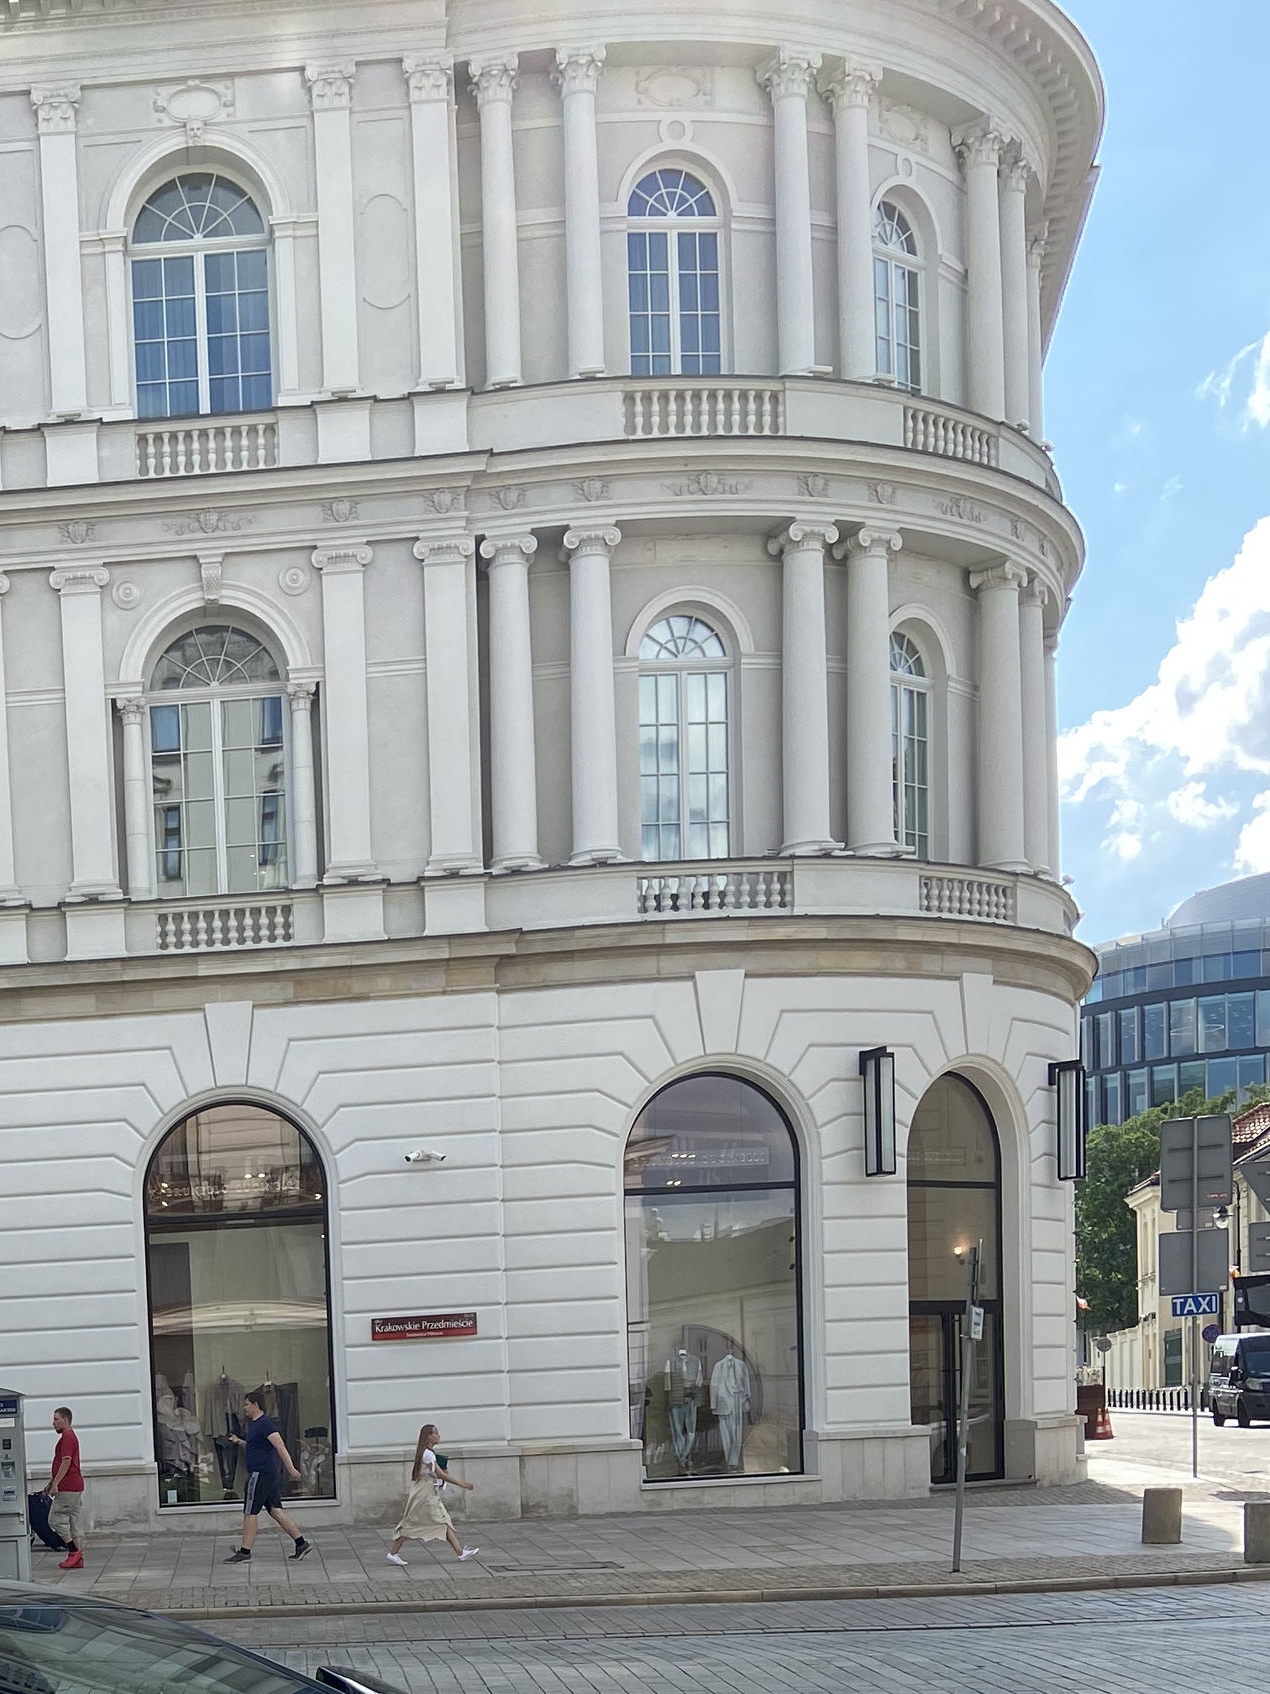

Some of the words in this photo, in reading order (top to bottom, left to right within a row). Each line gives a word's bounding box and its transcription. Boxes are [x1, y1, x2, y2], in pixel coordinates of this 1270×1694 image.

[1174, 1295, 1219, 1315] TAXI
[375, 1321, 420, 1333] Krakowskie
[422, 1318, 474, 1330] Przedmieście
